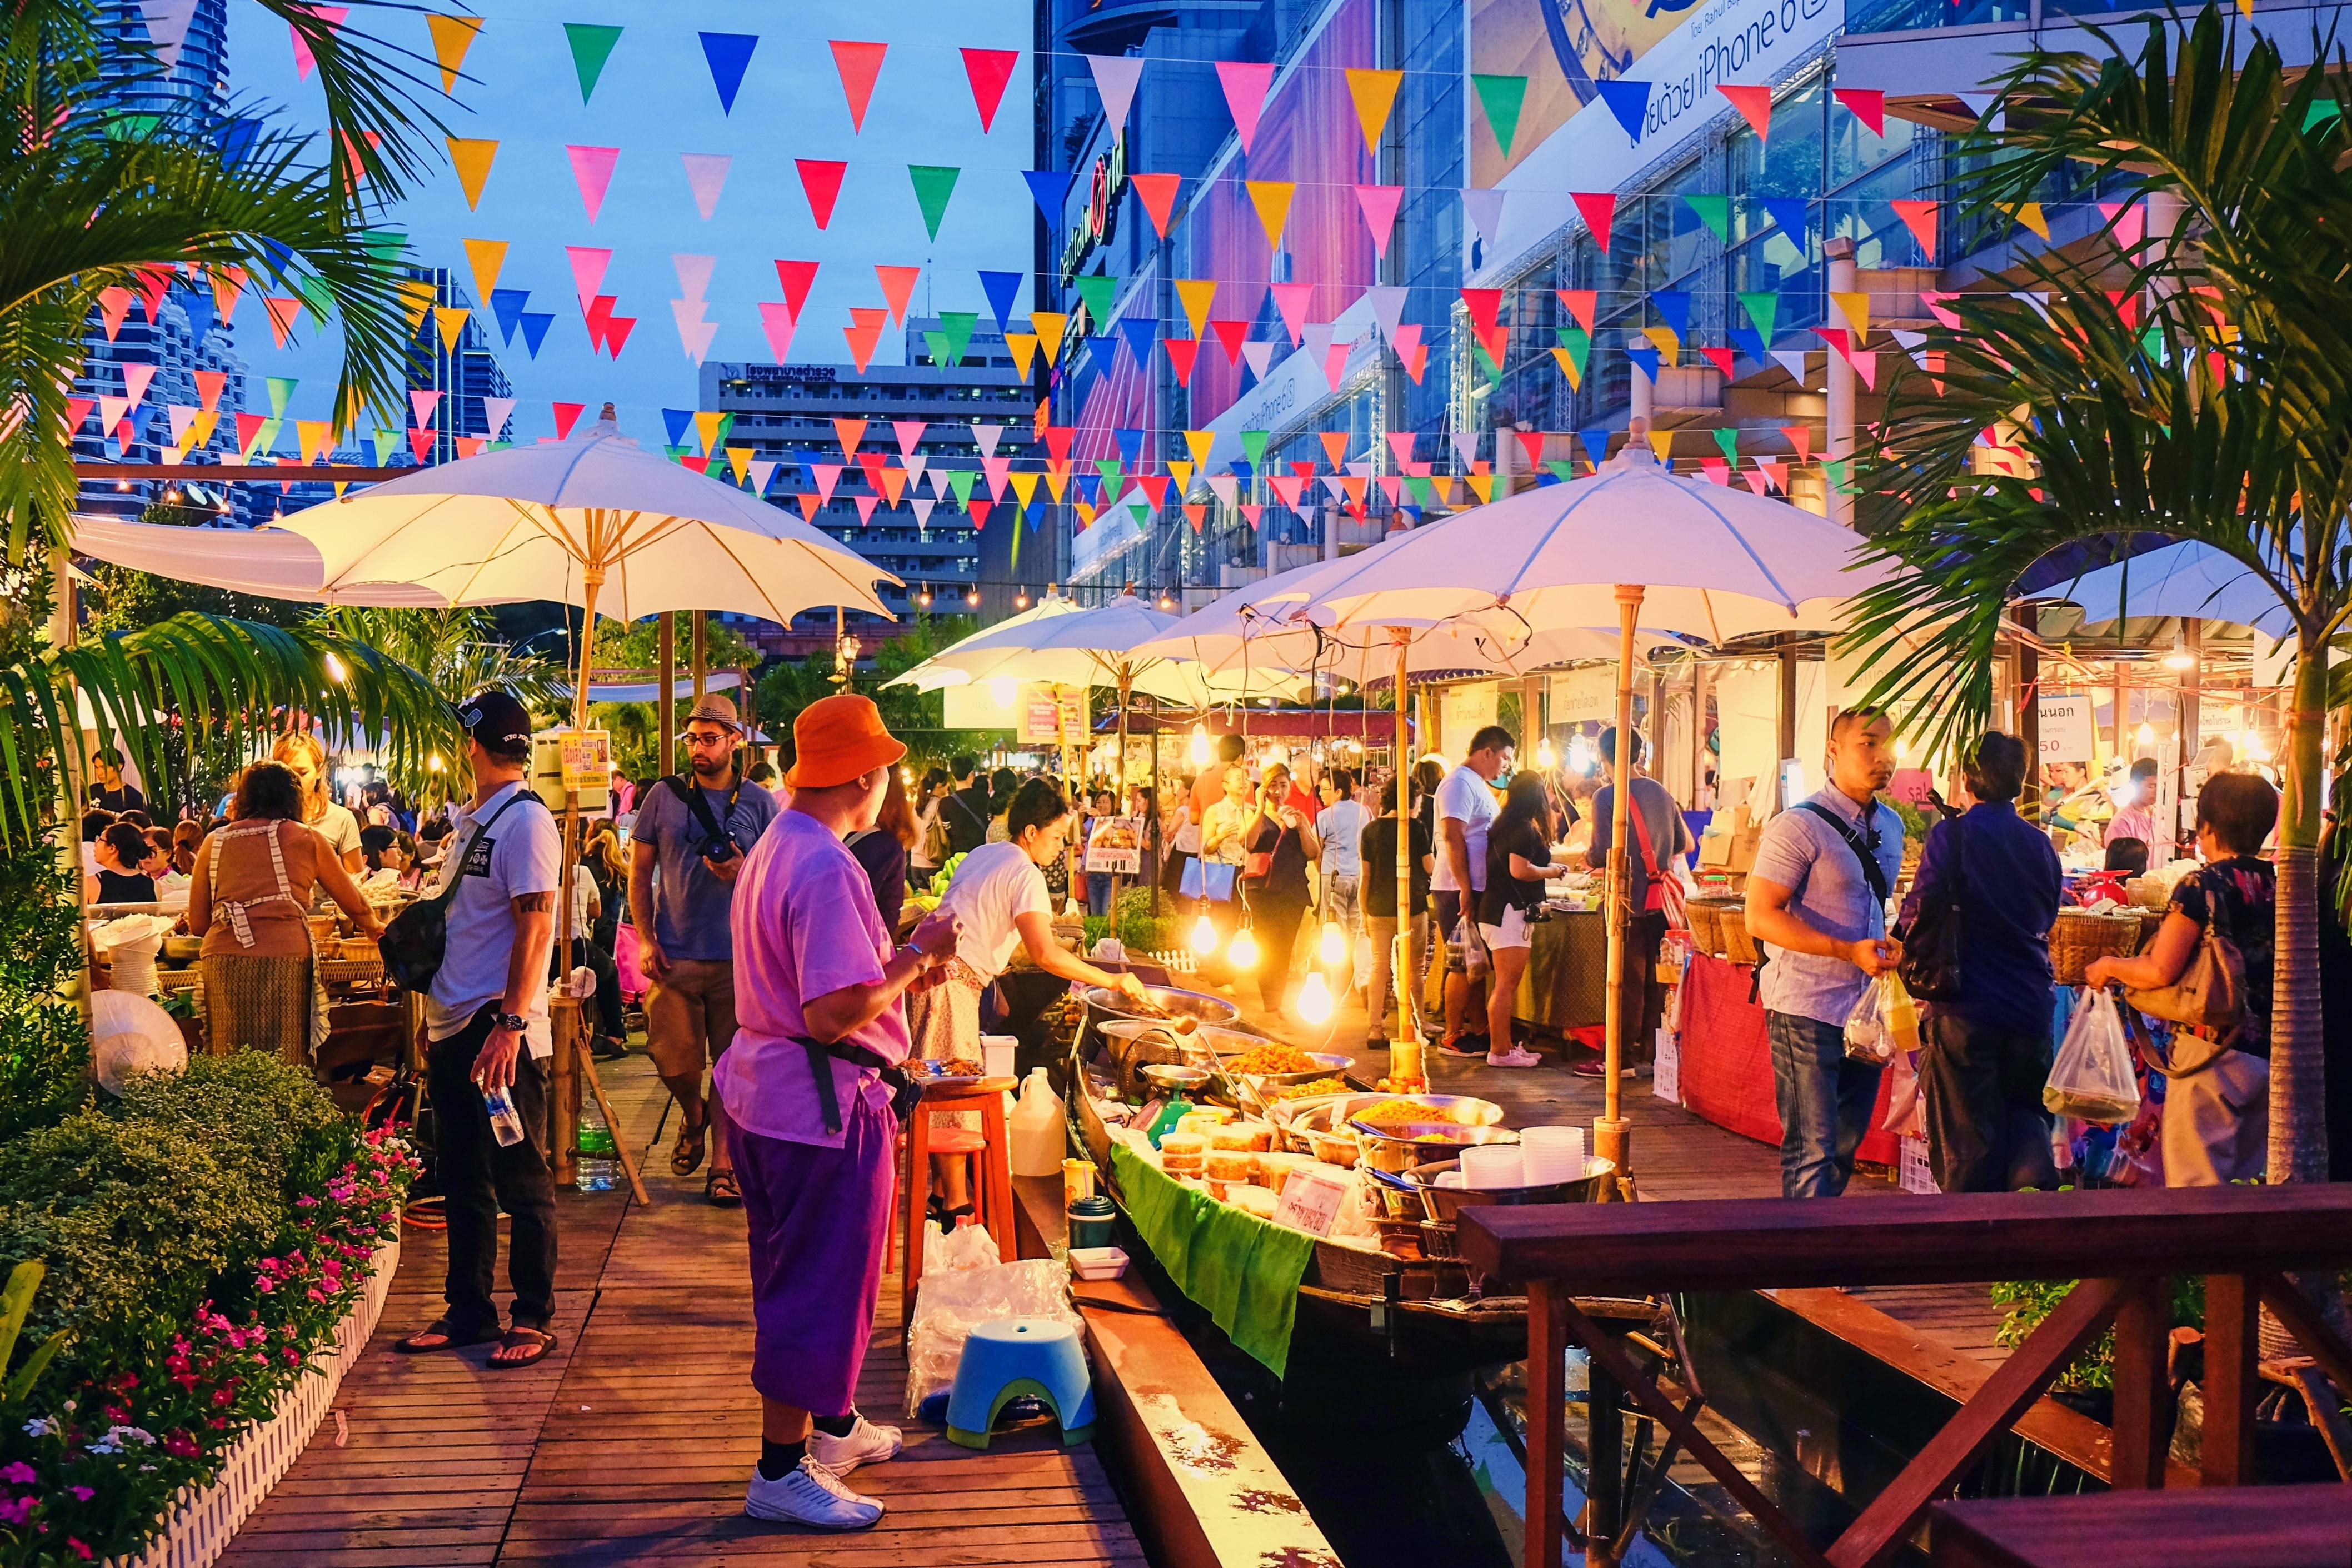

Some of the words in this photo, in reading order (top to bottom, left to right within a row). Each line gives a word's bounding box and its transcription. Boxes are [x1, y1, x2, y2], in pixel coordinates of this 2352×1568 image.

[1704, 0, 1725, 28] Rahul
[1630, 73, 1694, 149] ายด้วย
[1699, 10, 1775, 98] iPhone
[746, 363, 836, 376] โรงพยาบาลตำรวจ
[502, 733, 517, 742] NYC
